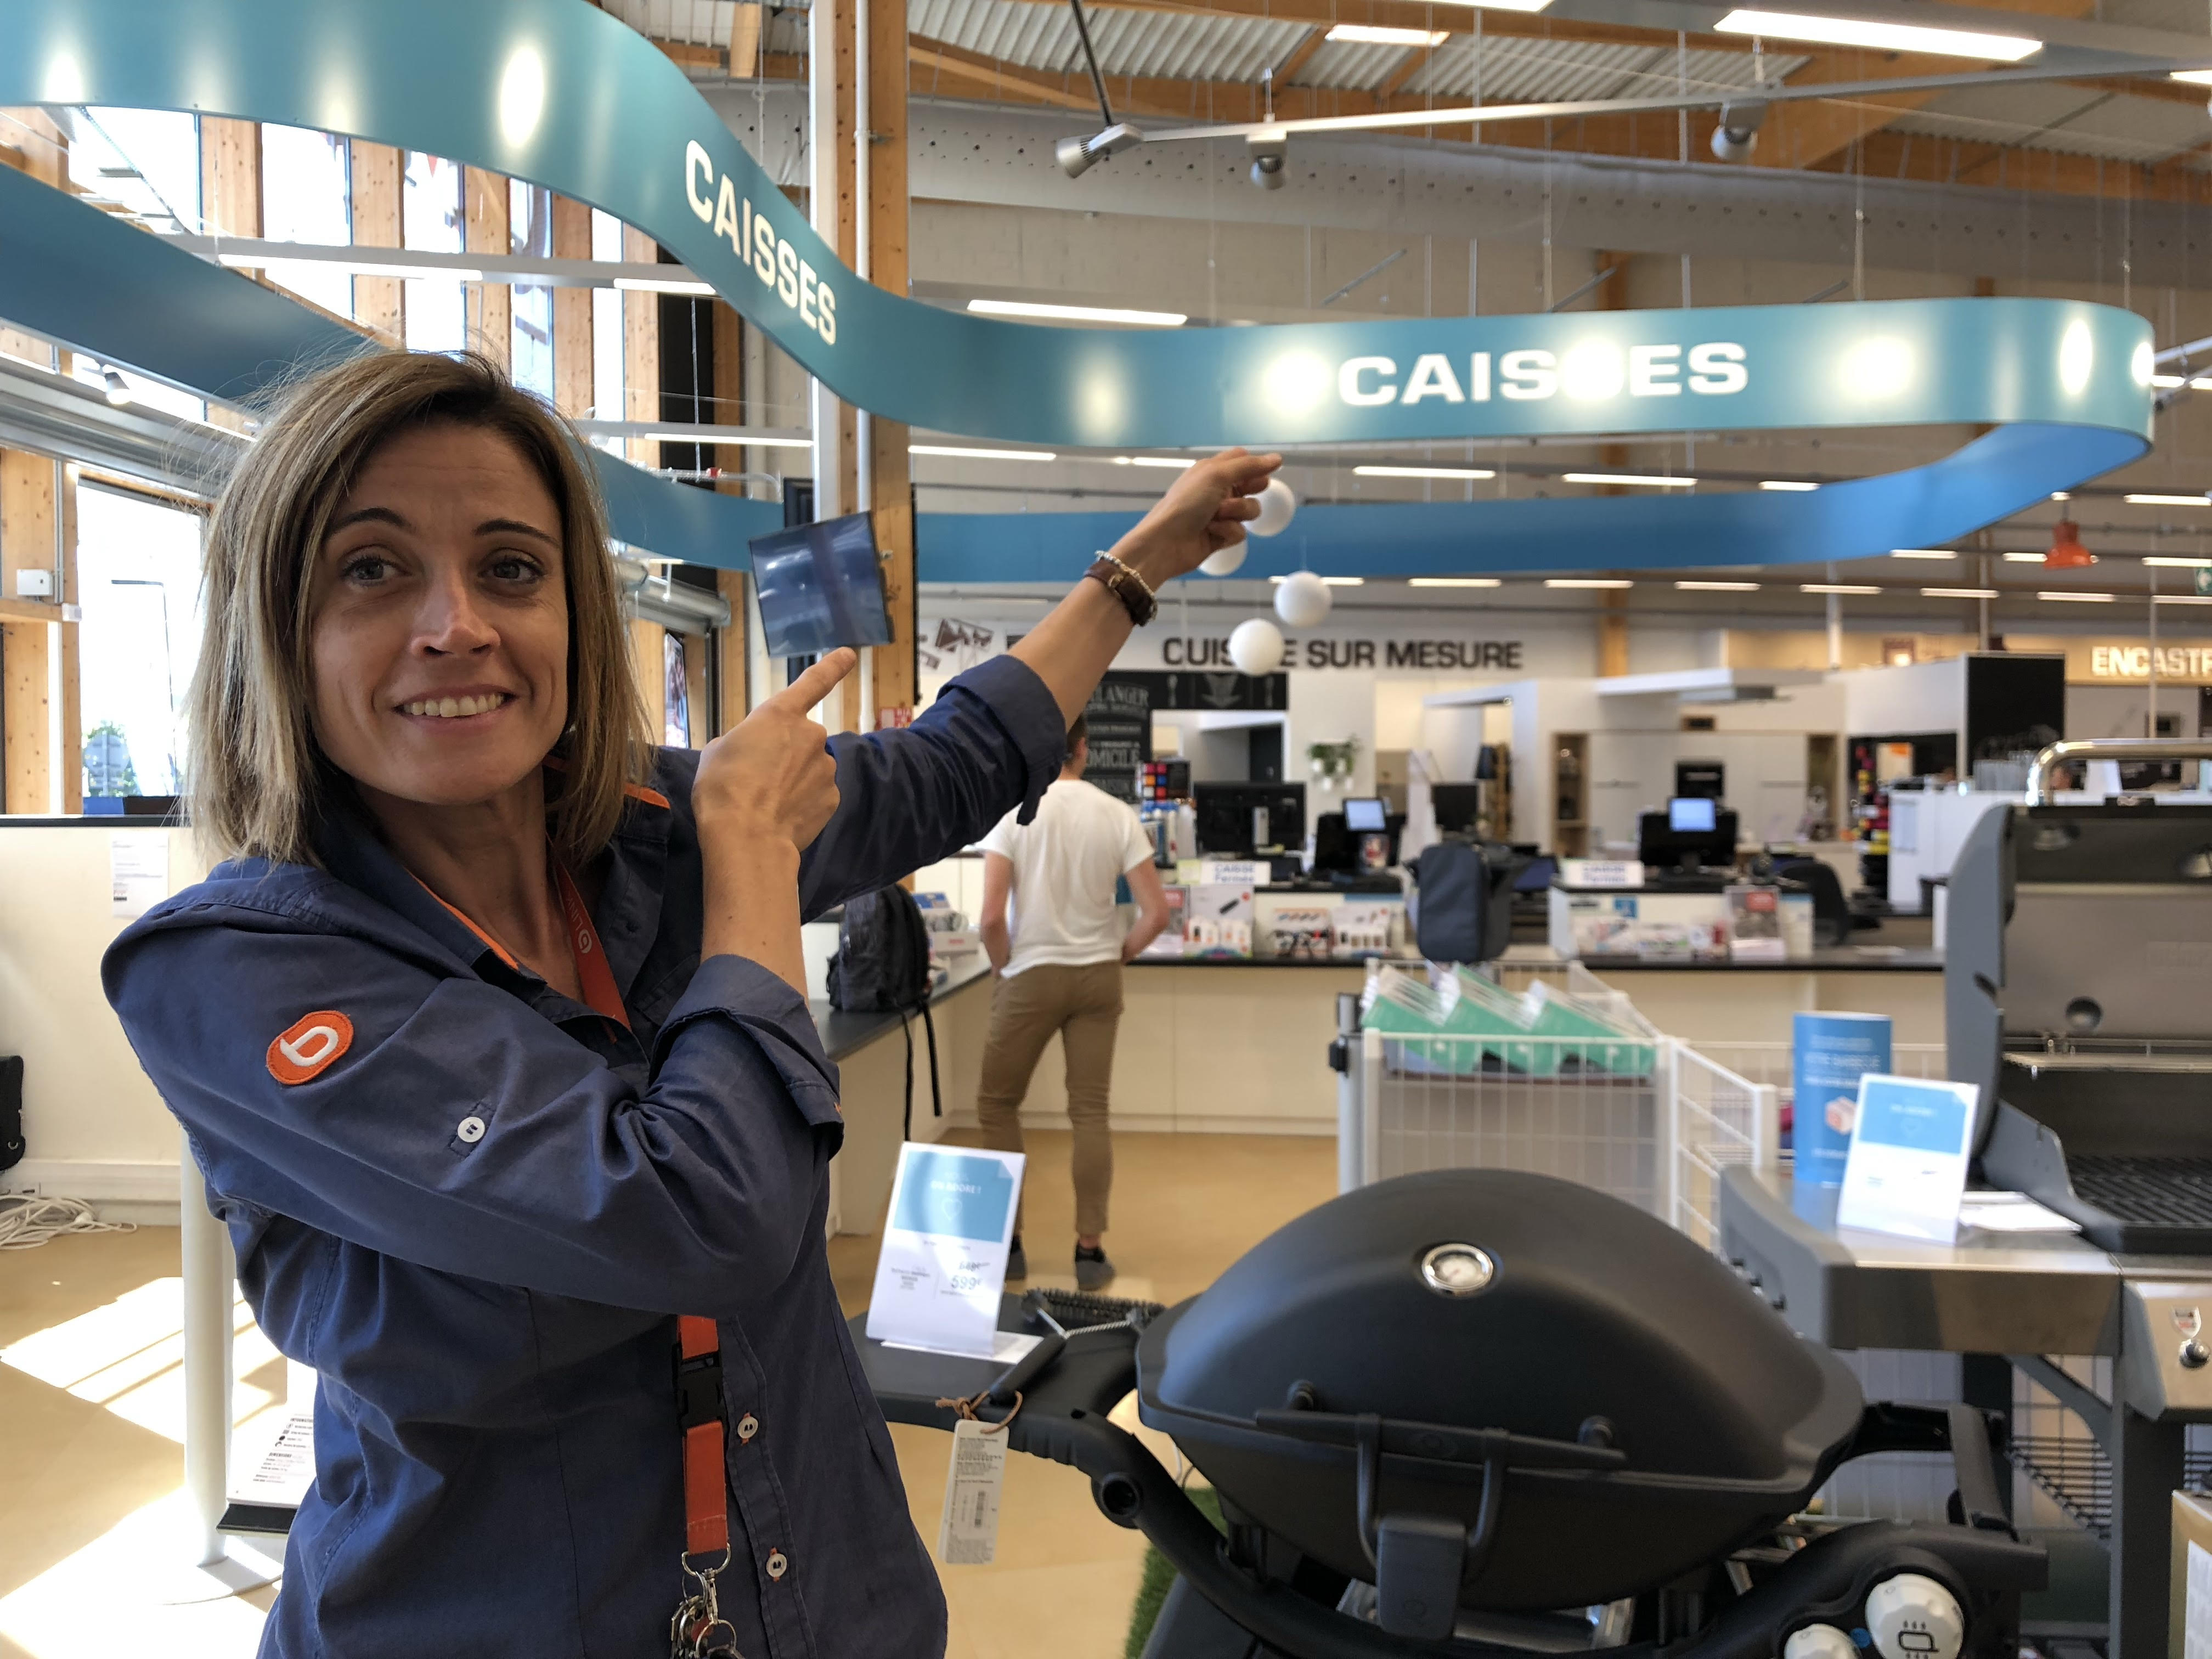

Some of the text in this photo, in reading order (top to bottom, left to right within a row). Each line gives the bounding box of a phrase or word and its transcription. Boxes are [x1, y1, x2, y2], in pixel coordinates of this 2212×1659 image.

[686, 139, 836, 345] CAISSES
[1338, 342, 1748, 407] CAISES
[1163, 637, 1523, 669] CUIE SUR MESURE
